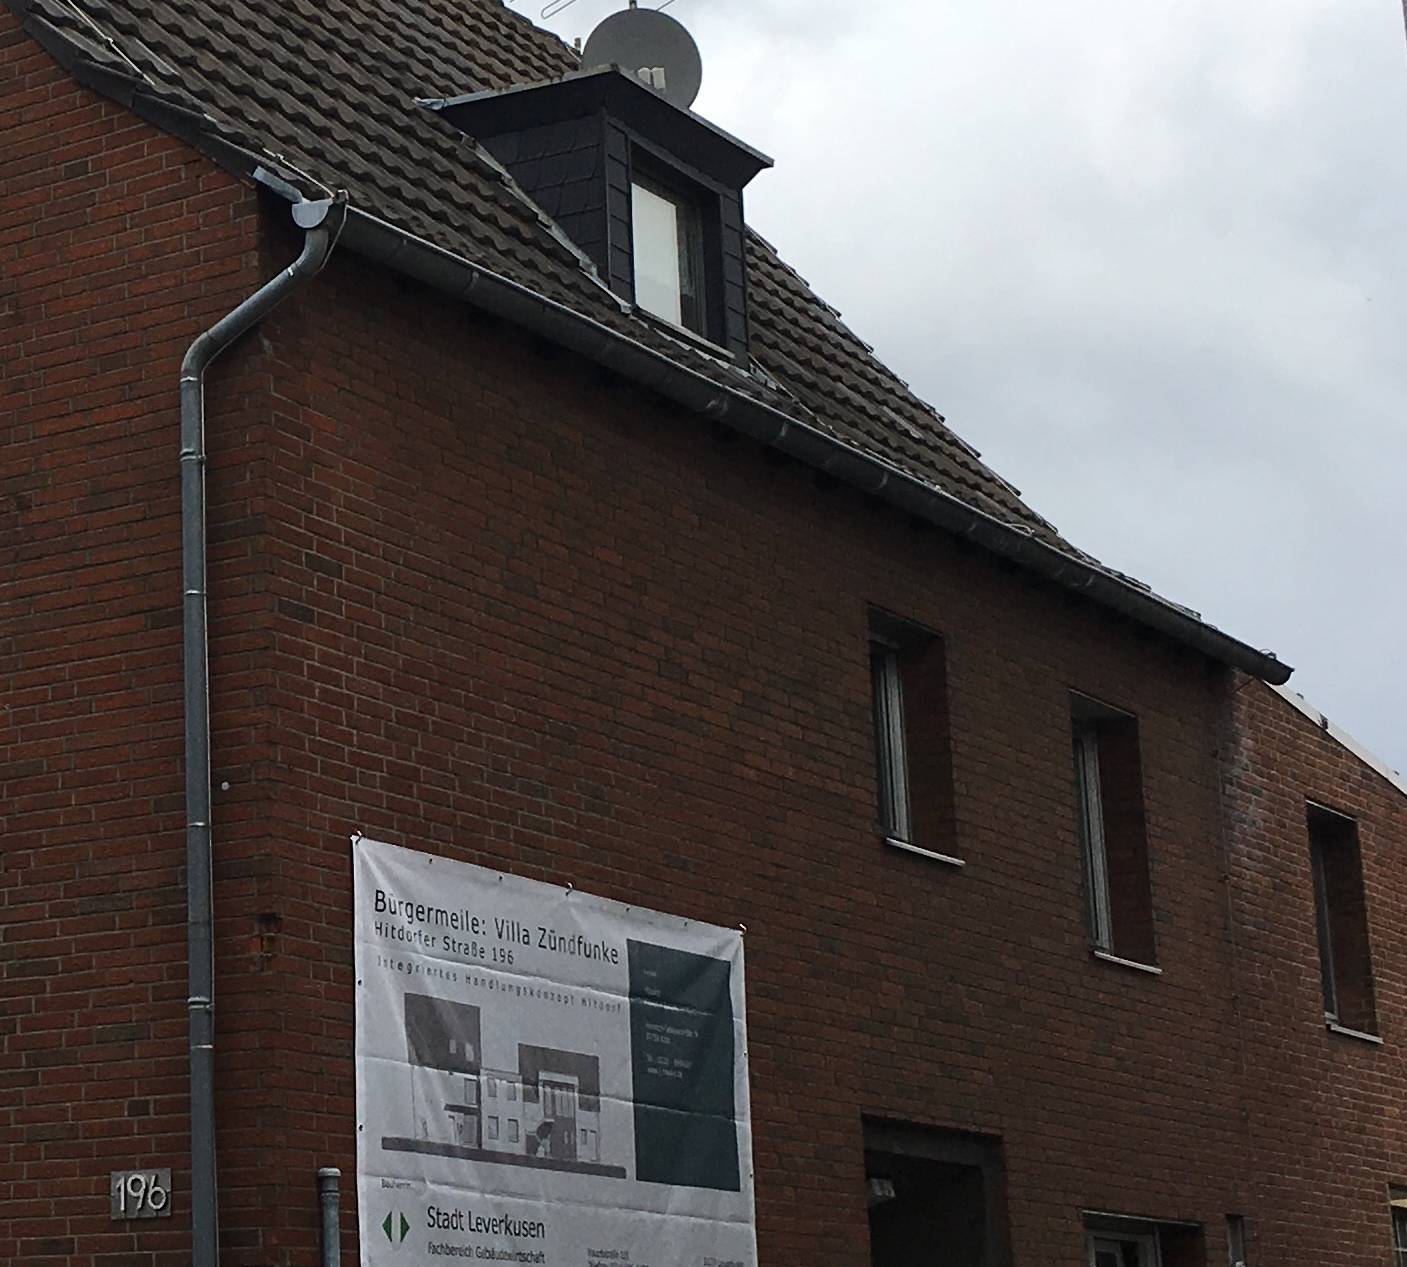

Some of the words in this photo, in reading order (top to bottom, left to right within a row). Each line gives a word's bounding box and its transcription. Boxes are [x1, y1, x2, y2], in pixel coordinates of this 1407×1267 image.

[374, 889, 487, 935] Bürgermeile:
[495, 917, 531, 946] Villa
[538, 926, 620, 966] Zündfunke
[374, 921, 436, 948] Hitdorfer
[443, 935, 485, 959] Straße
[492, 947, 515, 966] 196
[116, 1173, 167, 1212] 196
[427, 1206, 465, 1231] Stadt
[468, 1211, 546, 1240] Leverkusen
[428, 1241, 474, 1258] Fachbereich
